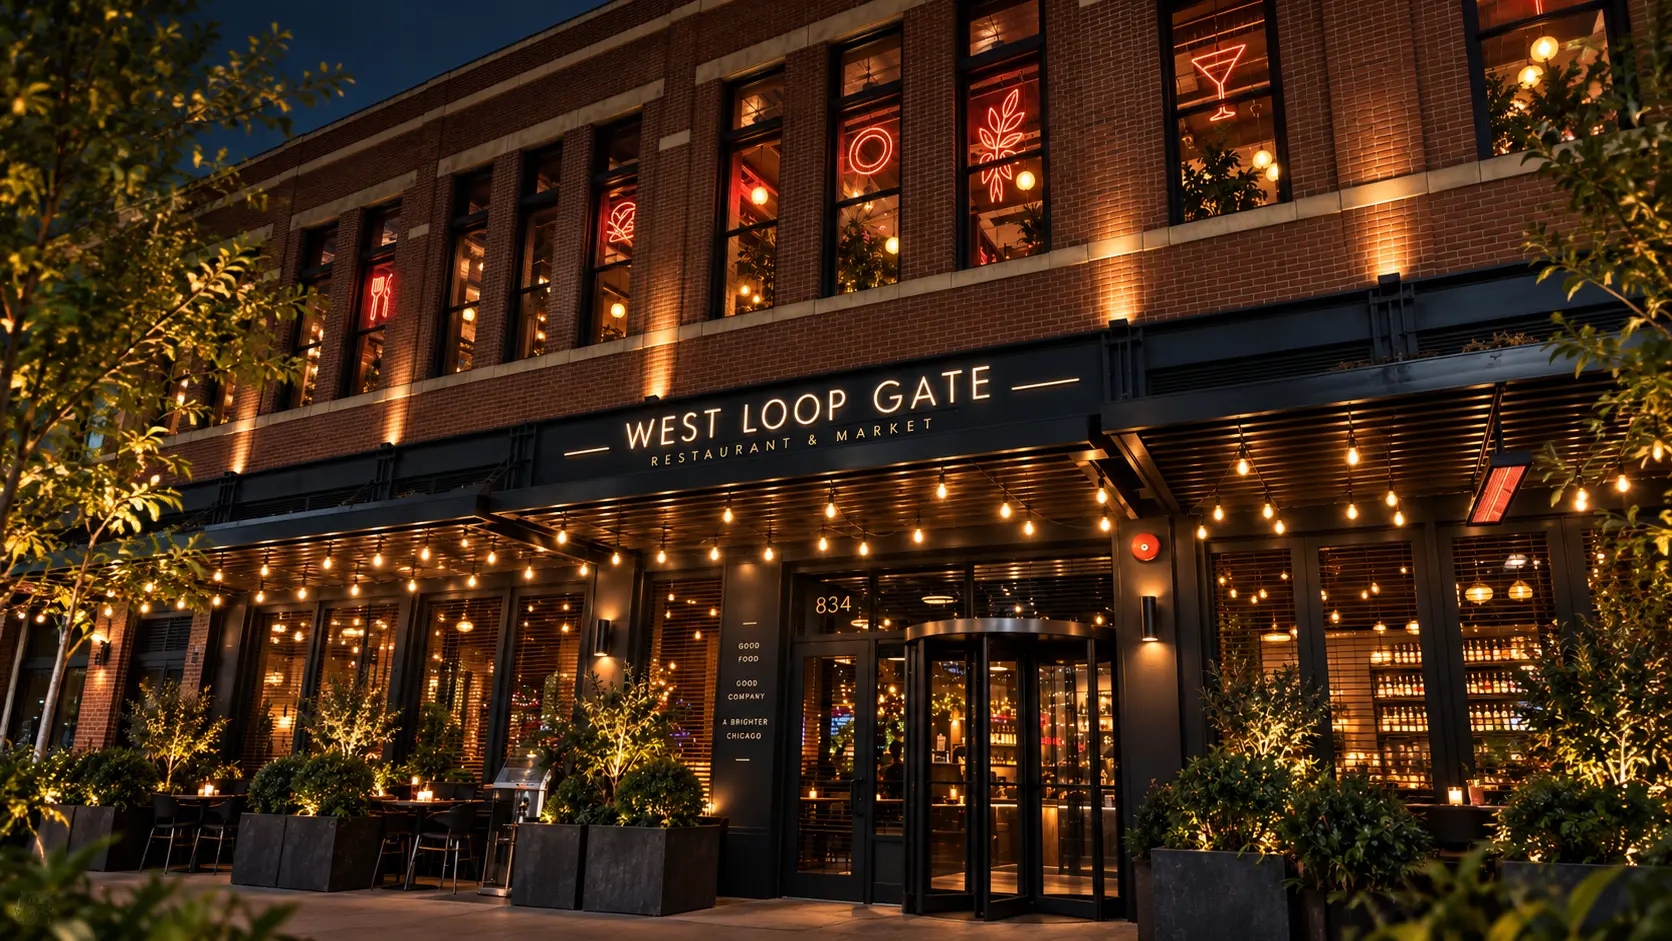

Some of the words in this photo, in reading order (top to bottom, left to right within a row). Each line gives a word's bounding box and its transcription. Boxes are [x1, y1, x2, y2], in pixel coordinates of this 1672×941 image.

[625, 407, 723, 450] WEST
[743, 389, 847, 434] LOOP
[873, 365, 991, 414] GATE
[651, 437, 791, 467] RESTAURANT
[808, 434, 817, 446] &
[836, 417, 932, 442] MARKET
[815, 595, 852, 614] 834
[738, 642, 760, 650] GOOD
[738, 655, 759, 663] FOOD
[736, 679, 758, 687] GOOD
[727, 692, 765, 701] COMPANY
[730, 718, 768, 726] BRIGHTER
[726, 732, 762, 740] CHICAGO
